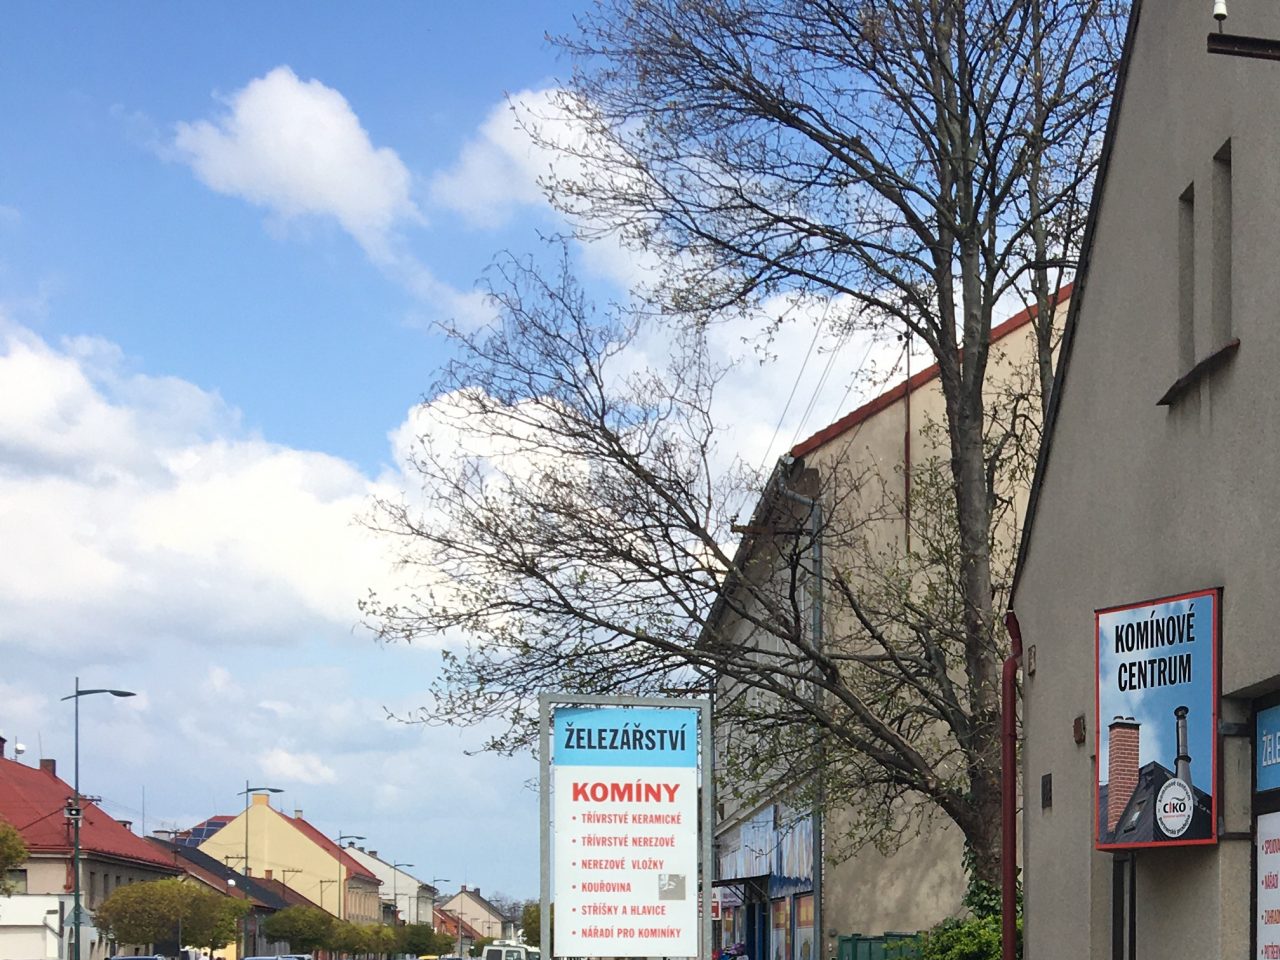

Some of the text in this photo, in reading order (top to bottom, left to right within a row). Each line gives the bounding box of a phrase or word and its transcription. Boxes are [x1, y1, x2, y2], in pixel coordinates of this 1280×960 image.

[1115, 604, 1195, 654] KOMÍNOVÉ
[1118, 654, 1192, 692] CENTRUM
[564, 722, 687, 751] ŽELEZÁŘSTVÍ
[572, 779, 681, 803] KOMÍNY
[1163, 801, 1186, 814] CIKO
[581, 810, 682, 825] TŘÍVRSTVÉ KERAMICKÉ
[581, 834, 675, 848] TŘÍVRSTVÉ NEREZOVÉ
[581, 857, 664, 870] NEREZOVÉ VLOŽKY
[581, 880, 631, 893] KOUŘOVINA
[581, 902, 666, 916] STŘÍŠKY A HLAVICE
[581, 925, 681, 939] NÁŘADÍ PRO KOMINÍKY
